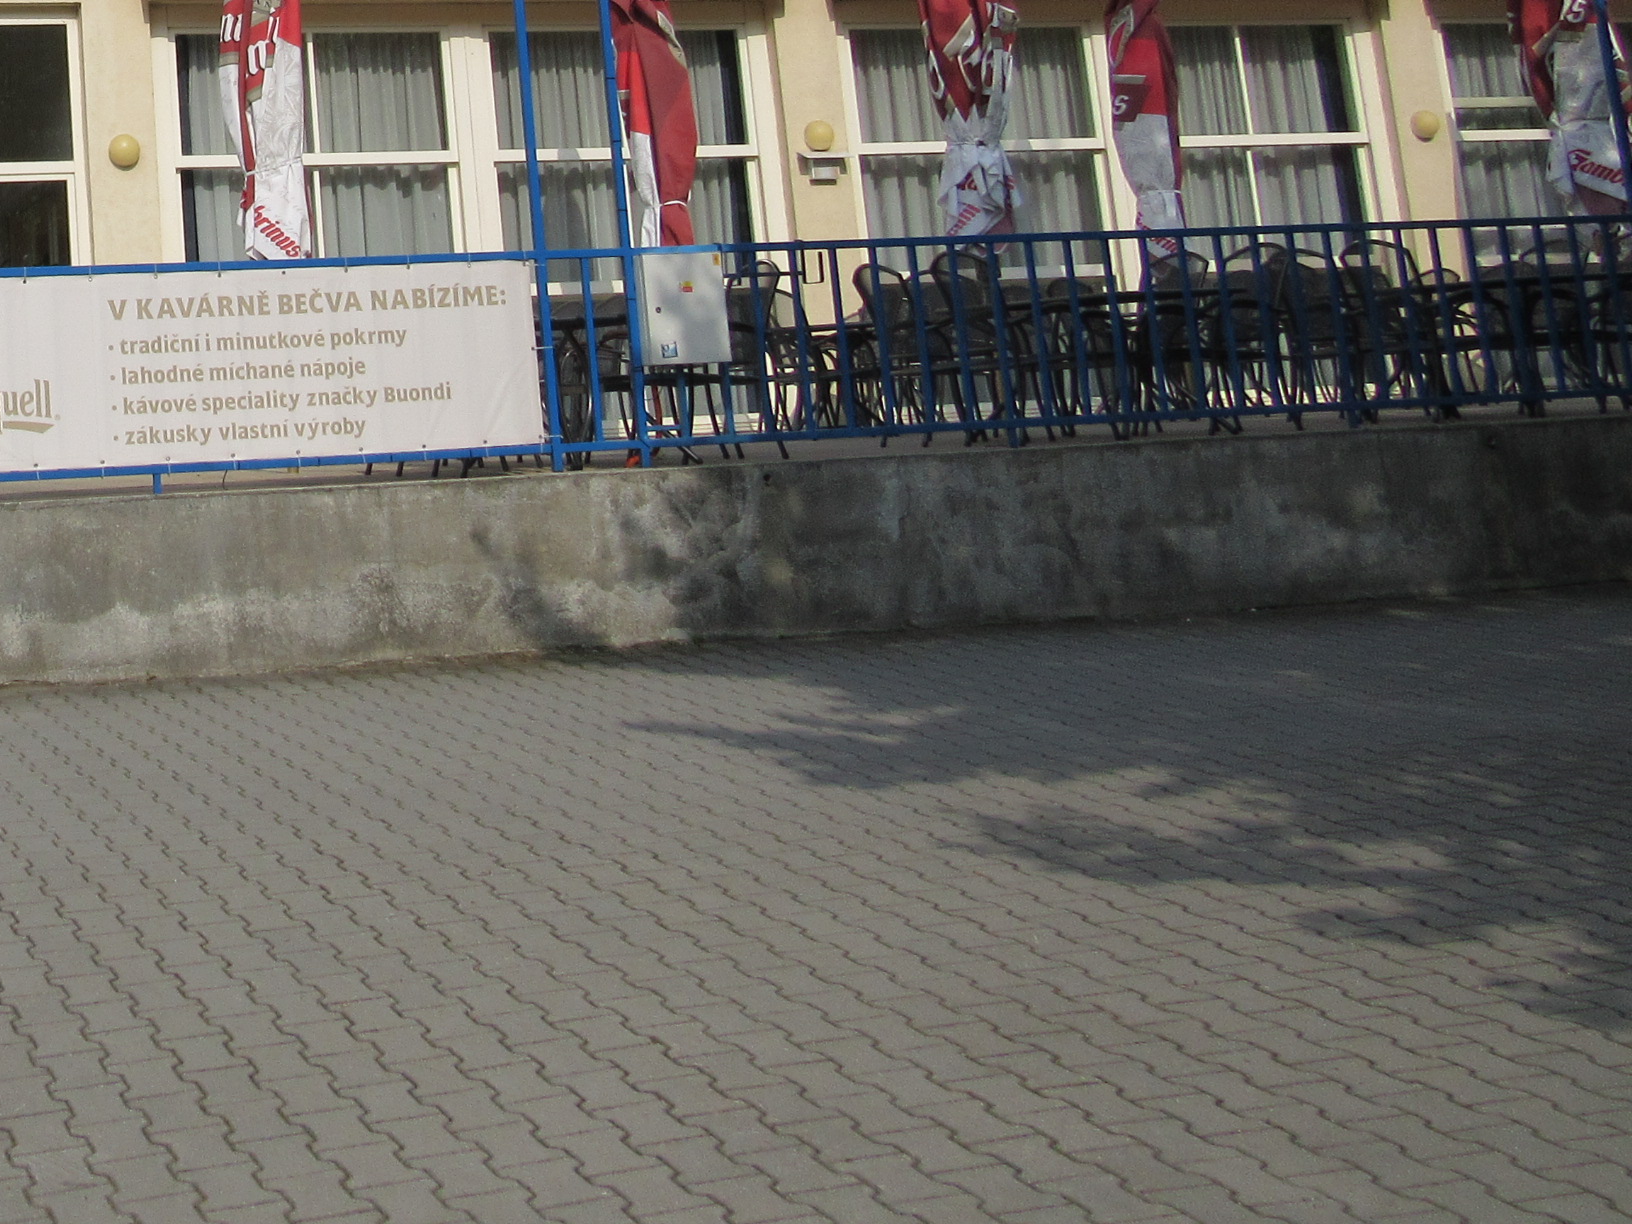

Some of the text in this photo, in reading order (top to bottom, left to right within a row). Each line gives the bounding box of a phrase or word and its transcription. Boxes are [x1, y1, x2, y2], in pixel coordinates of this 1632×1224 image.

[108, 283, 506, 320] V KAVÁRNĚ BEČVA NABÍZÍME:
[119, 328, 407, 355] tradiční i minutkové pokrmy
[121, 357, 366, 385] lahodné míchané nápoje
[123, 381, 452, 415] kávové speciality značky Buondi
[125, 417, 366, 446] zákusky vlastní výroby
